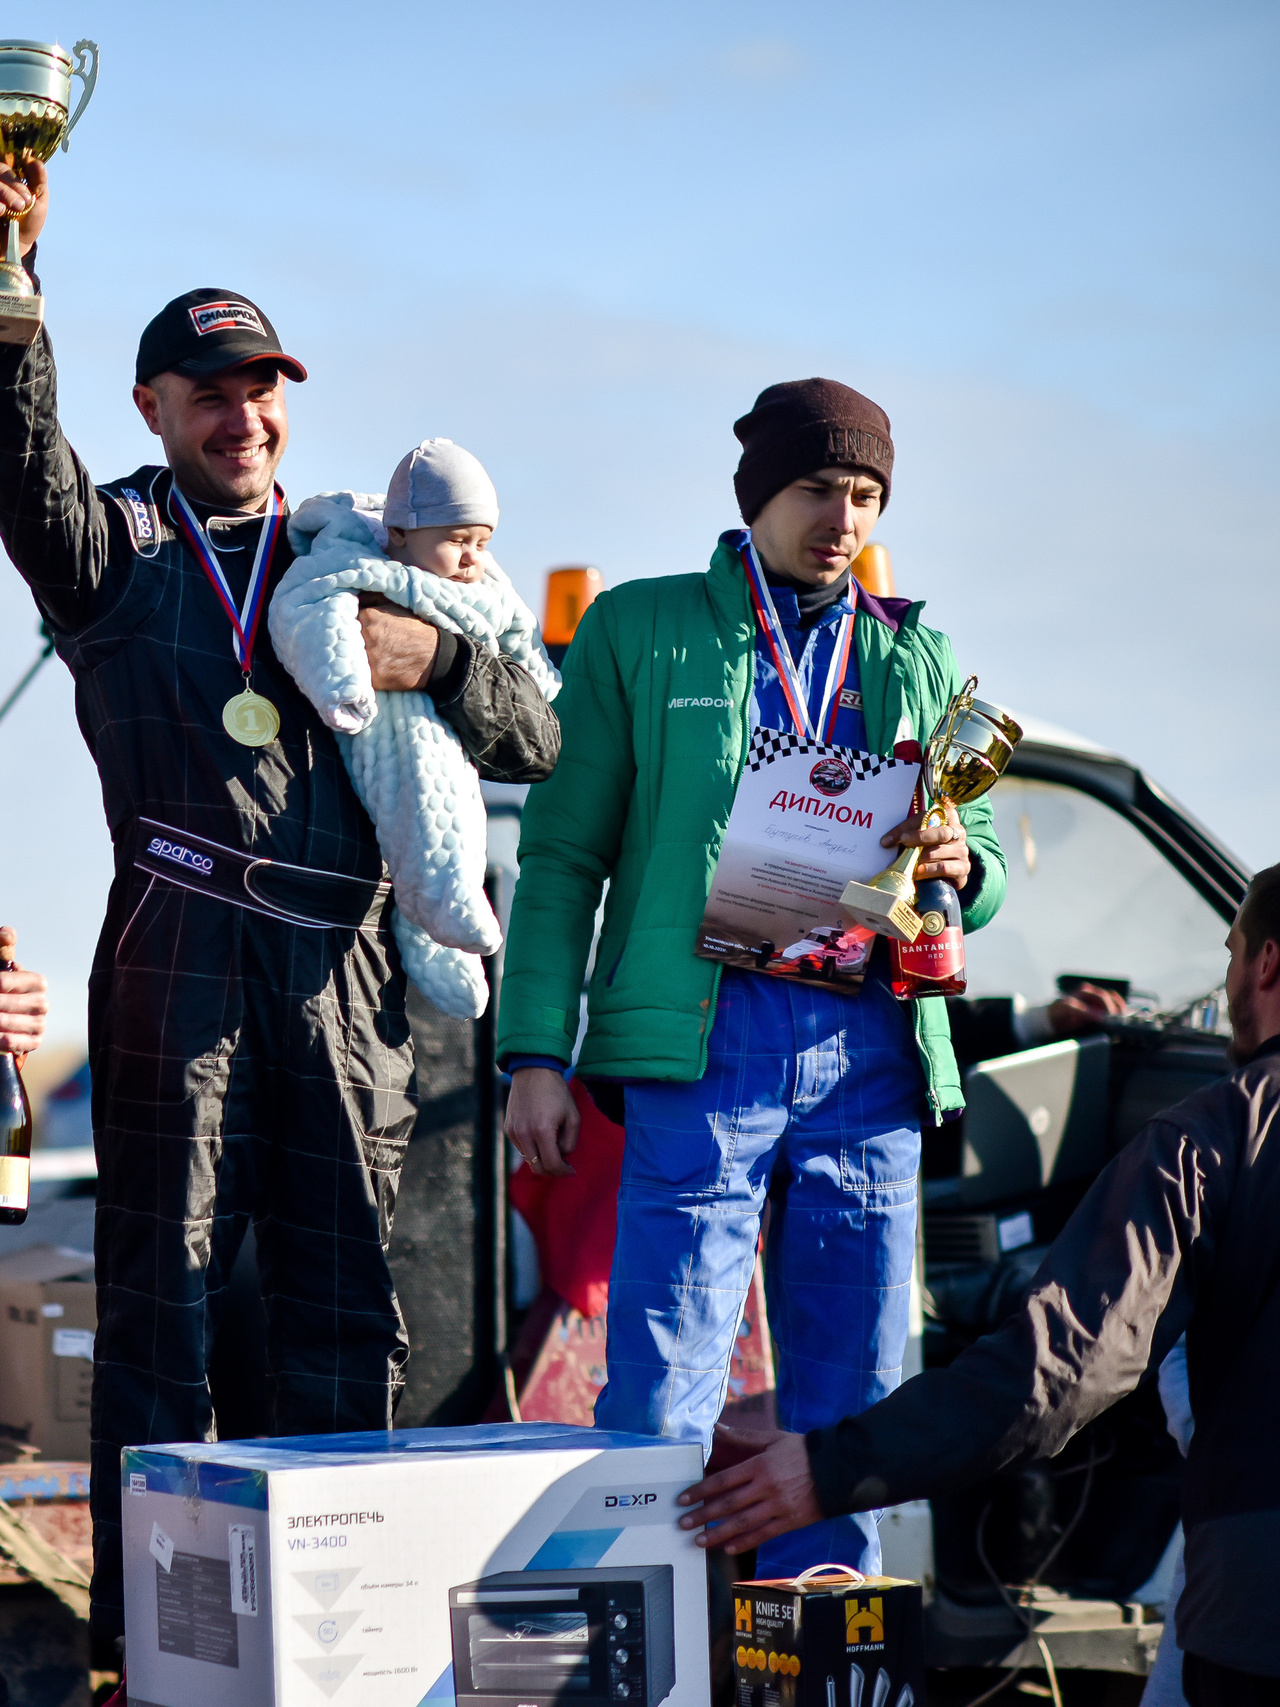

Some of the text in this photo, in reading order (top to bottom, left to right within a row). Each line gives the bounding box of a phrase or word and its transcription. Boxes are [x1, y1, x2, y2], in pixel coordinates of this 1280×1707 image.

[198, 309, 261, 326] CHAMPION
[121, 487, 153, 538] sparco
[668, 697, 734, 709] МЕГАФОН
[242, 708, 260, 731] 1
[769, 790, 873, 829] ДИПЛОМ
[148, 837, 213, 876] sparco
[928, 952, 944, 960] RED
[605, 1493, 658, 1508] DEXP
[287, 1511, 385, 1529] ЭЛЕКТРОПЕЧЬ
[288, 1535, 347, 1550] VN-3400
[756, 1601, 797, 1620] KNIFE SET
[846, 1643, 885, 1654] HOFFMANN
